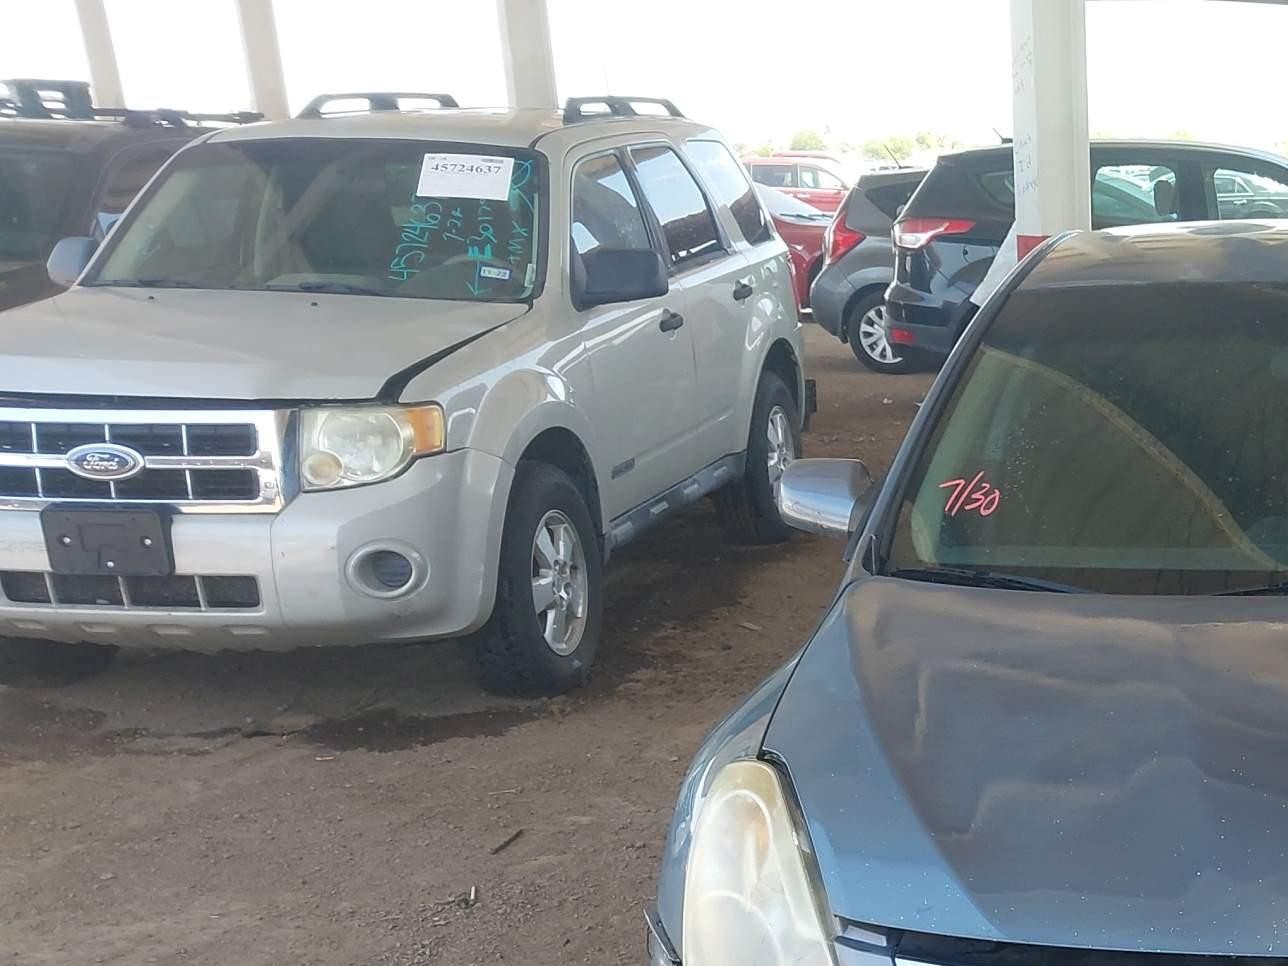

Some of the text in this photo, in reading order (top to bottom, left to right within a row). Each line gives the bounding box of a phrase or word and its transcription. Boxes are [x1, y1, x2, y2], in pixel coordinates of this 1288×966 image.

[431, 163, 502, 174] 45724637
[83, 453, 119, 470] Ford
[938, 470, 1001, 517] 7/30
